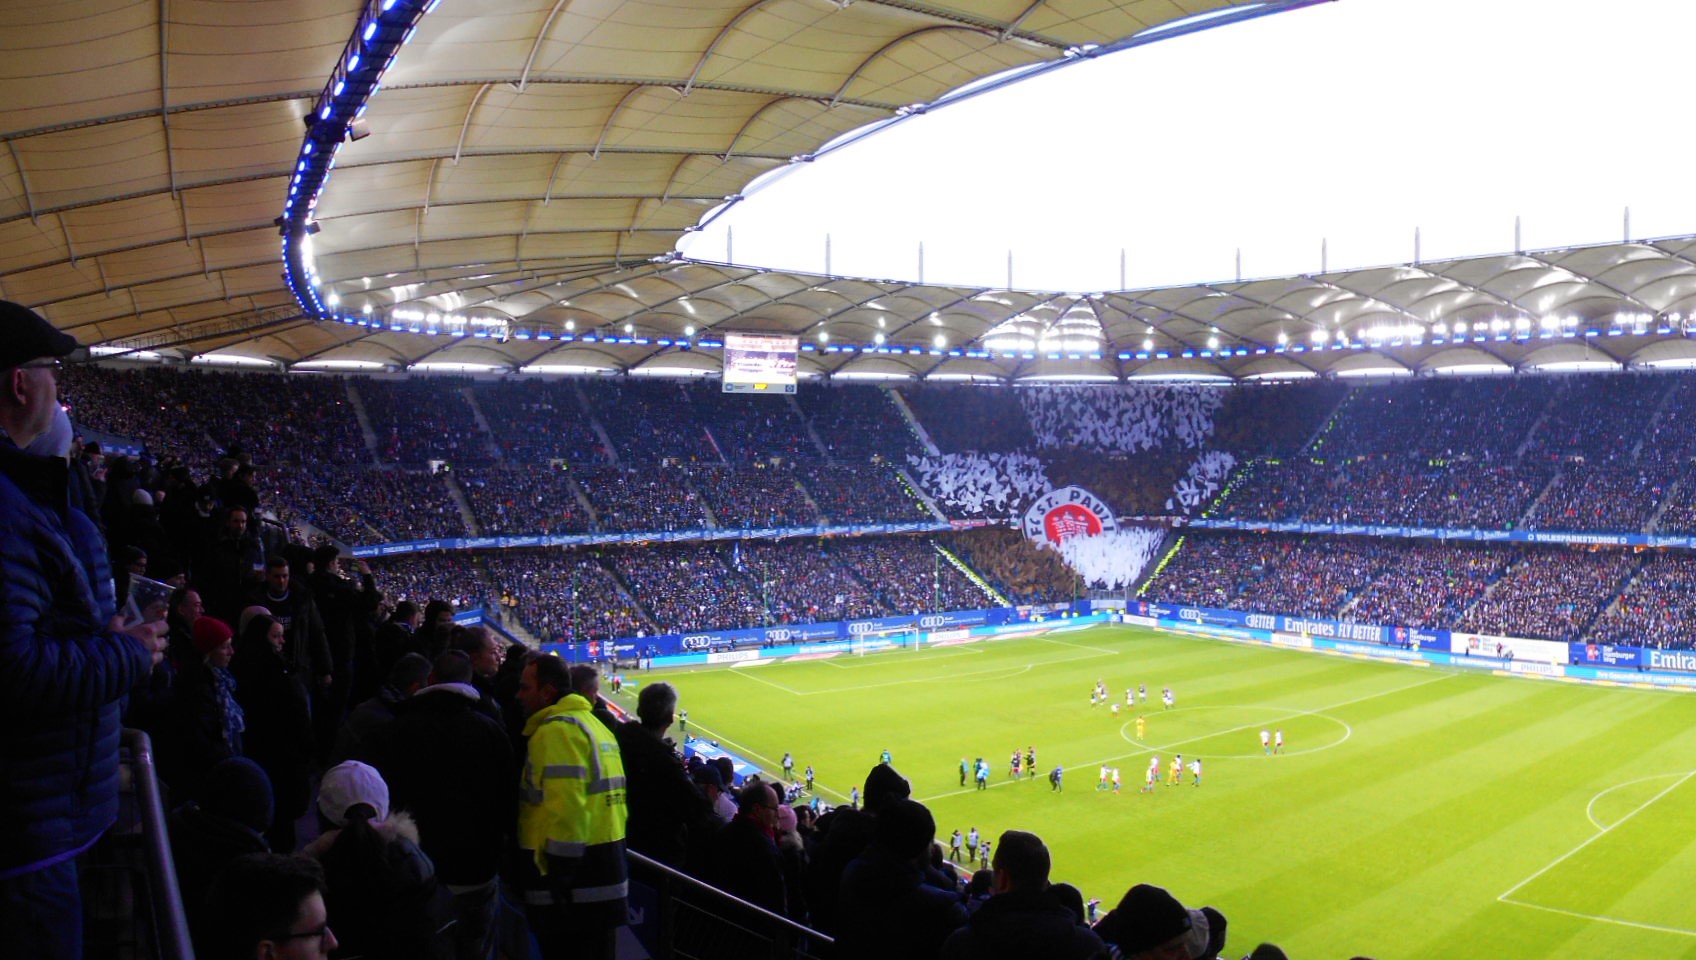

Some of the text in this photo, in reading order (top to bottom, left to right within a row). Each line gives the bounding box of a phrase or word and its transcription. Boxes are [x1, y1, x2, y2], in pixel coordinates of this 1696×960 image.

[1030, 490, 1115, 536] FC ST. PAULI
[1536, 534, 1619, 544] VOLKSPARKSTADION
[1250, 614, 1276, 630] BETTER
[1284, 618, 1381, 642] Emirates FLY BETTER
[1603, 651, 1635, 660] Hamburger
